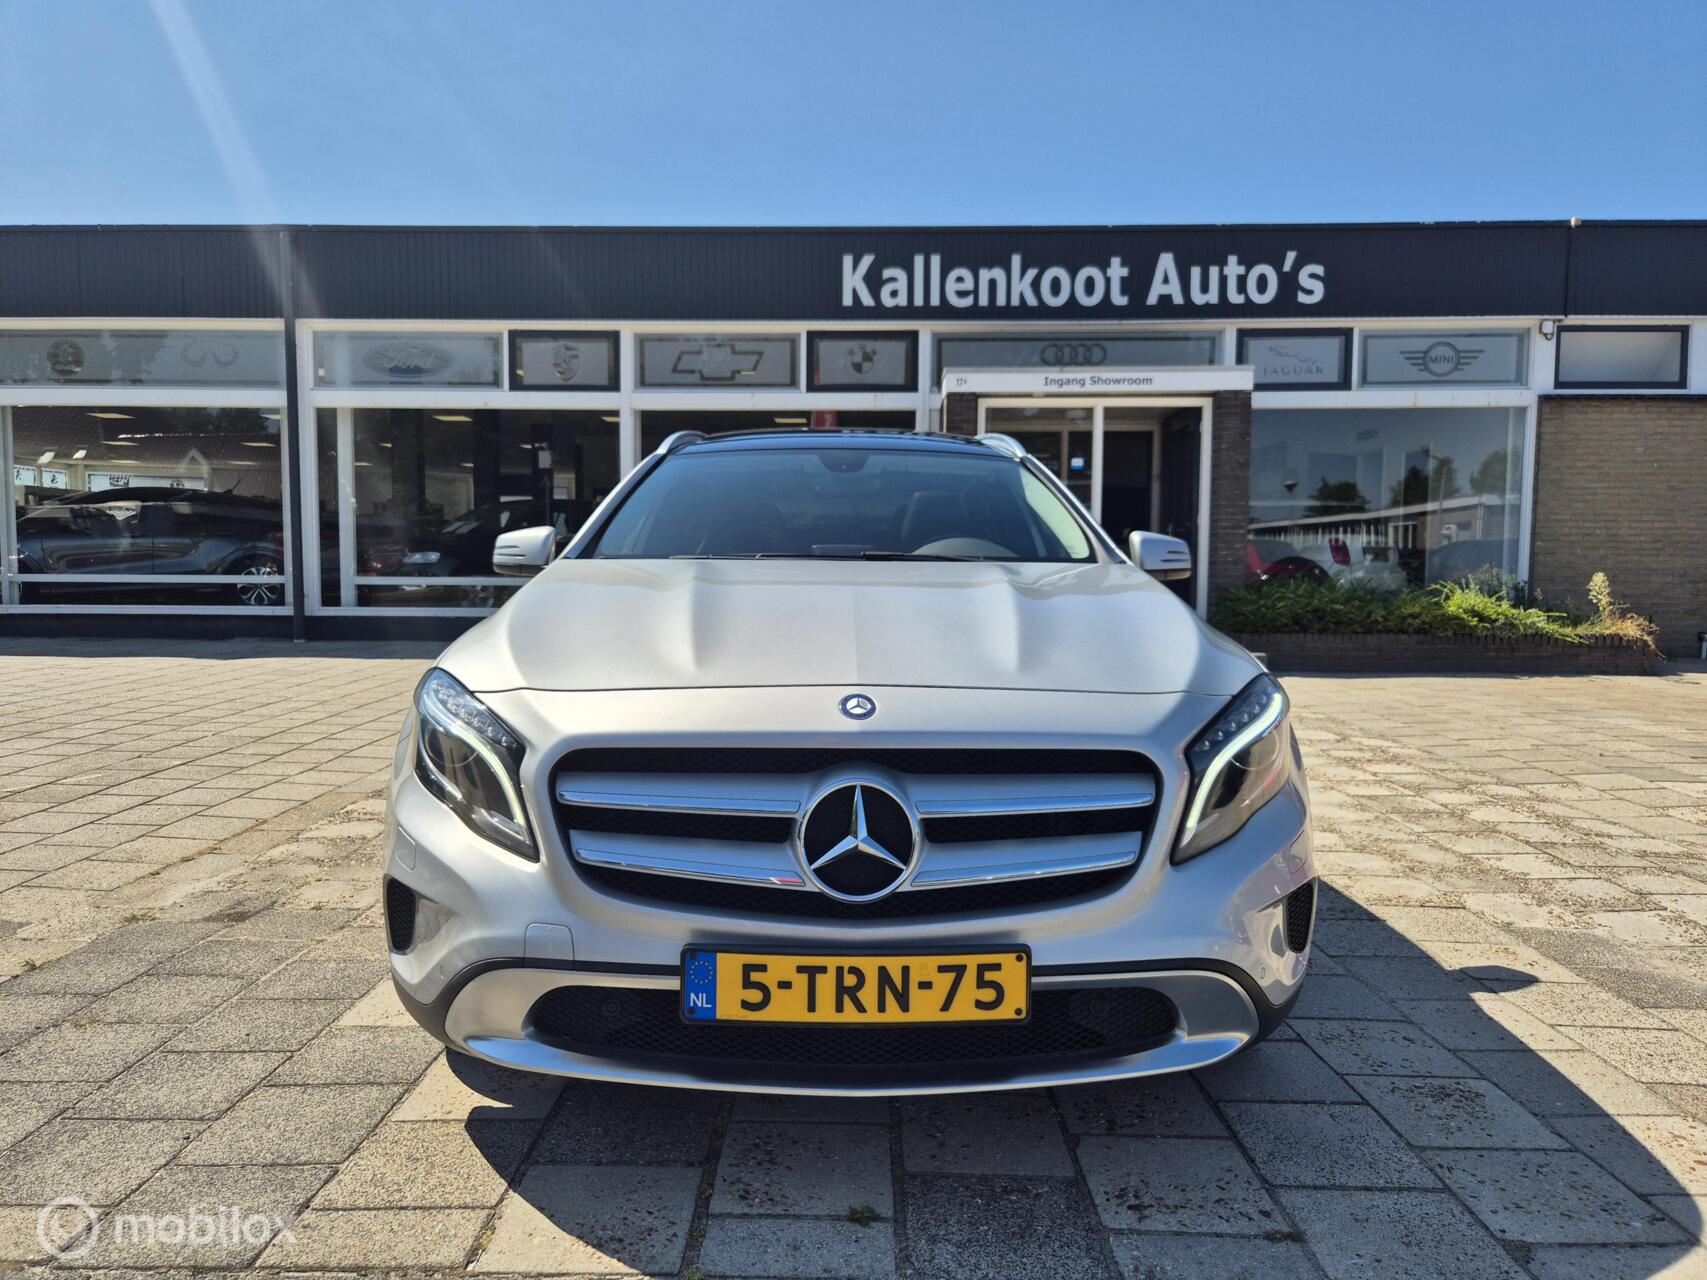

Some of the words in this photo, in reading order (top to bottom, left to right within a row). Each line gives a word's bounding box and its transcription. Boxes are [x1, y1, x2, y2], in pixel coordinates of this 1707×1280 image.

[841, 253, 1129, 308] Kallenkoot
[1146, 251, 1326, 306] Auto's
[1429, 355, 1455, 366] MINI
[1044, 376, 1086, 388] Ingang
[1089, 375, 1153, 386] Showroom
[740, 963, 1005, 1013] 5-TRN-75
[690, 992, 712, 1008] NL
